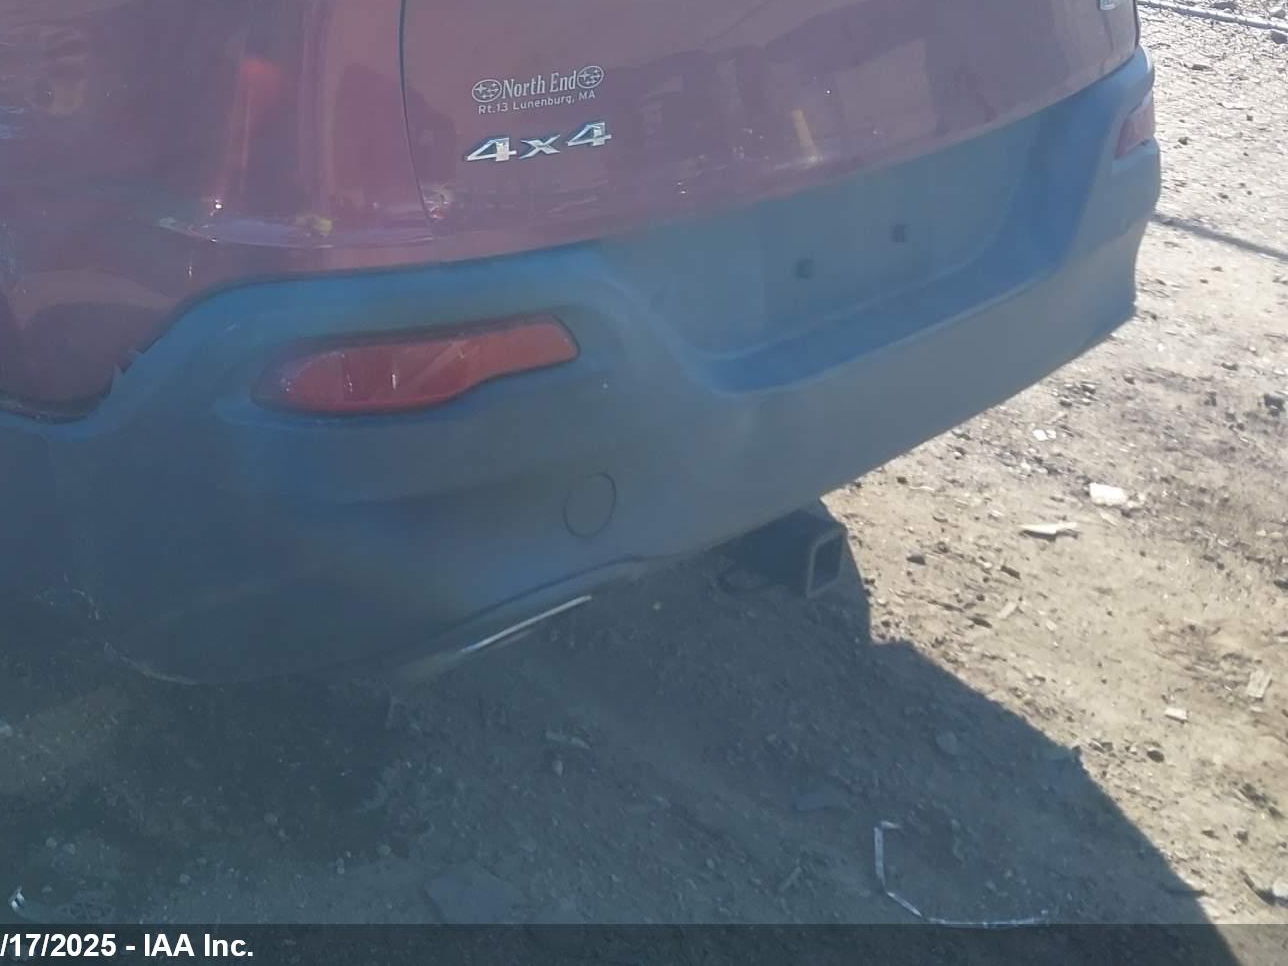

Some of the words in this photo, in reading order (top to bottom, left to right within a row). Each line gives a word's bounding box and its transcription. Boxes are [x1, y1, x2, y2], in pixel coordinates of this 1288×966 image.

[502, 75, 545, 99] North
[550, 70, 577, 93] End
[478, 103, 509, 114] Rt.13
[513, 94, 574, 111] Lunenburg,
[578, 90, 596, 101] MA
[467, 121, 612, 162] 4x4
